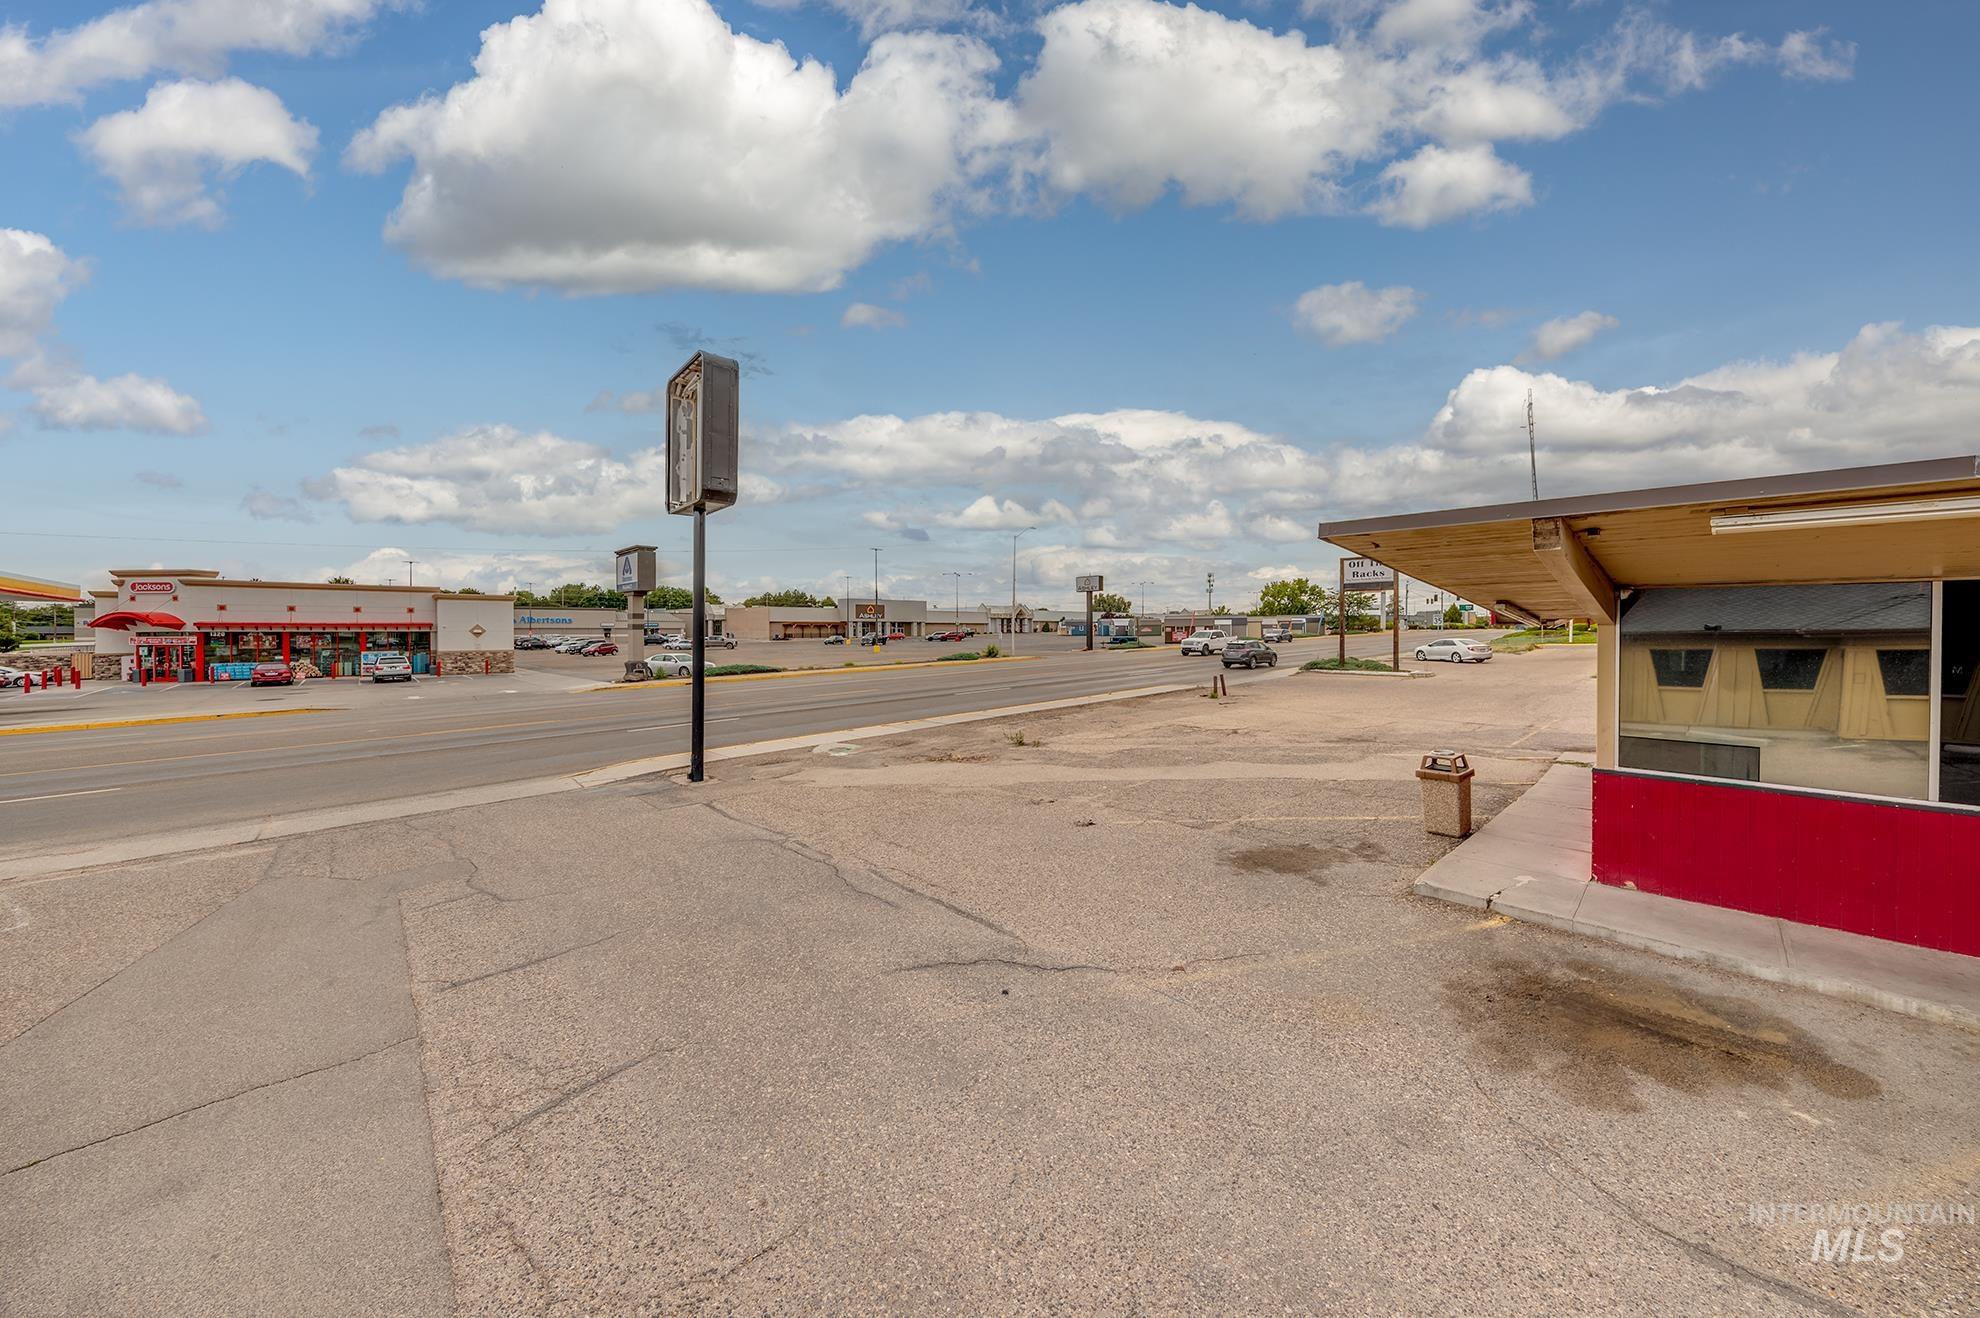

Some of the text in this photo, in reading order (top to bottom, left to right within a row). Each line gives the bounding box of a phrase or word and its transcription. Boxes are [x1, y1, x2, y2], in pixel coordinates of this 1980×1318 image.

[1348, 560, 1364, 568] Off
[1352, 570, 1385, 578] Racks
[134, 582, 171, 591] Jacksons
[520, 615, 573, 624] Albertsons
[1433, 617, 1443, 625] 35
